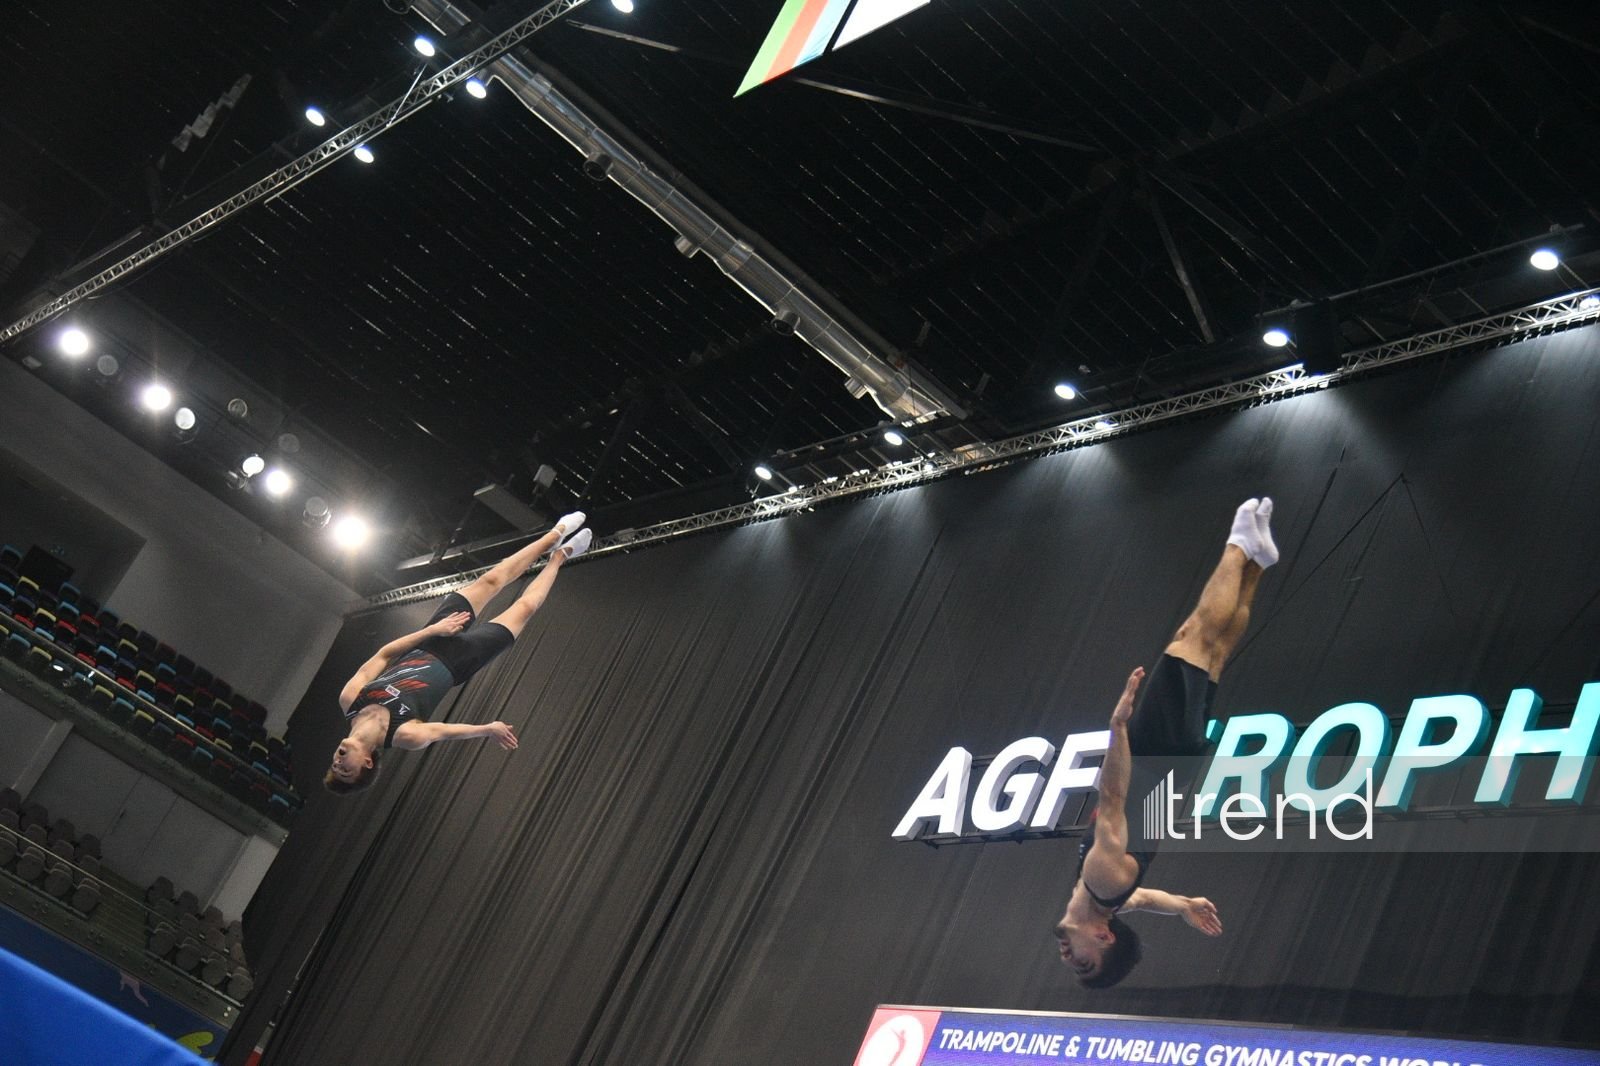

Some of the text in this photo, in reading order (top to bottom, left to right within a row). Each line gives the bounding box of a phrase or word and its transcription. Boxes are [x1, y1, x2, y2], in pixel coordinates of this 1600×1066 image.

[891, 682, 1600, 841] AGF ROPH
[939, 1028, 1065, 1056] TRAMPOLINE
[1064, 1035, 1080, 1058] &
[1085, 1036, 1202, 1066] TUMBLING
